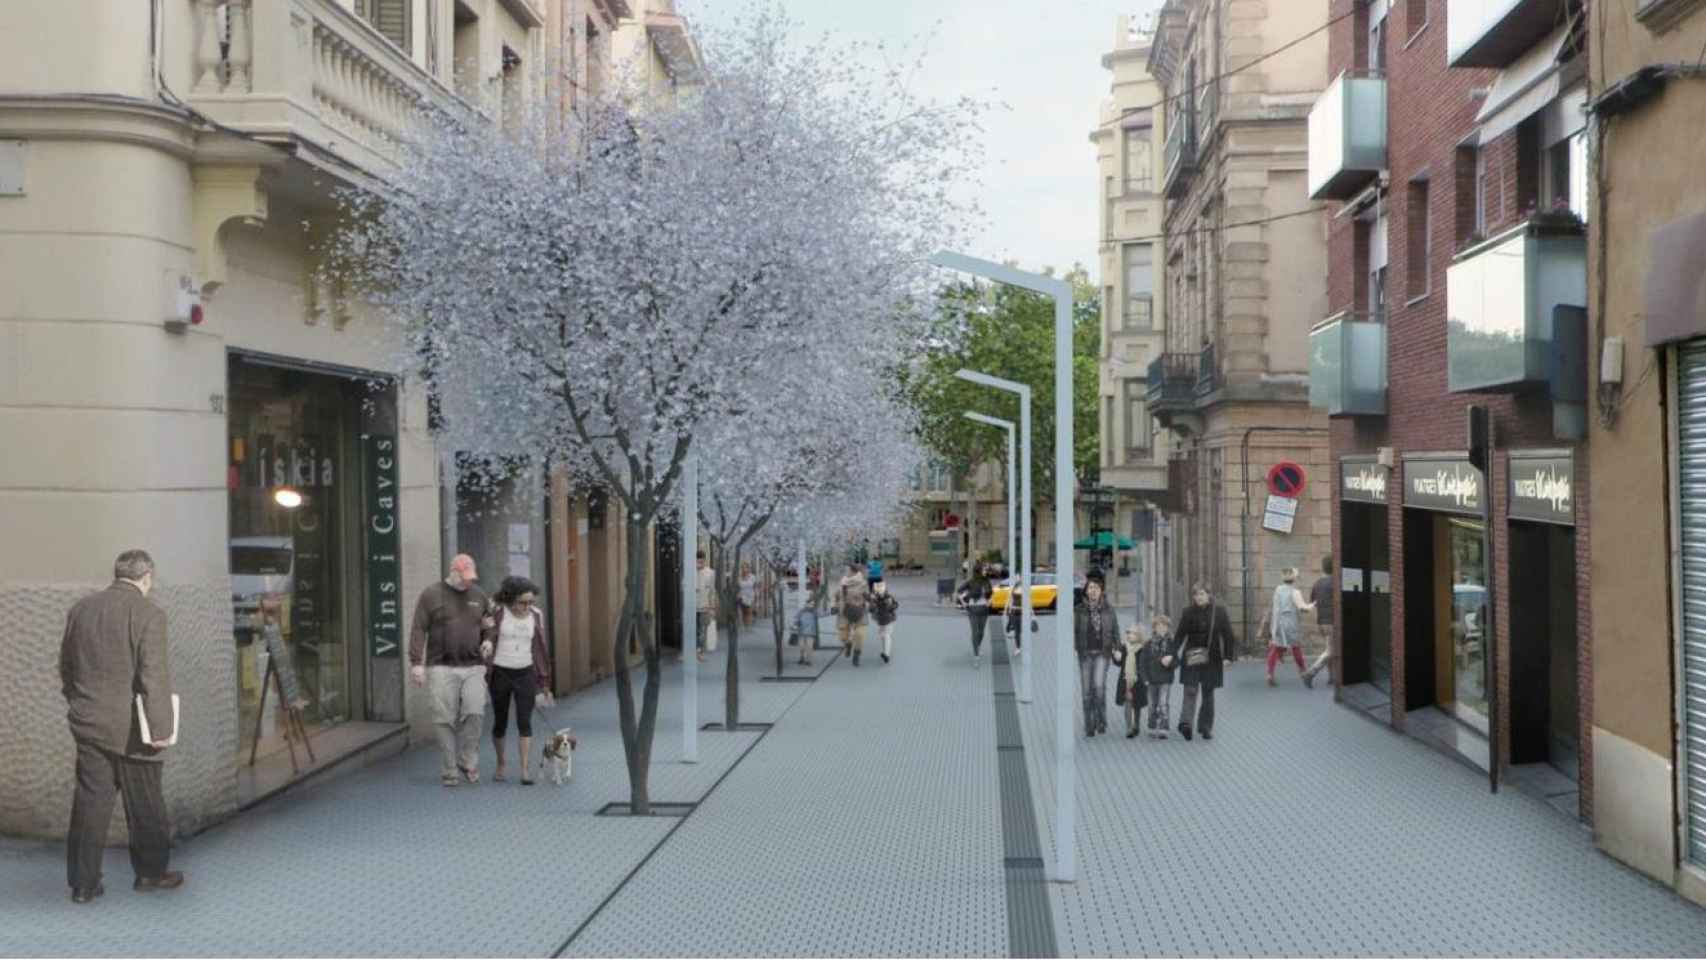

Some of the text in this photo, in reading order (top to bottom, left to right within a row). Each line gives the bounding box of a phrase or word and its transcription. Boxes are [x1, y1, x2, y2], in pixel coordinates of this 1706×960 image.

[371, 439, 397, 655] Vins i Caves
